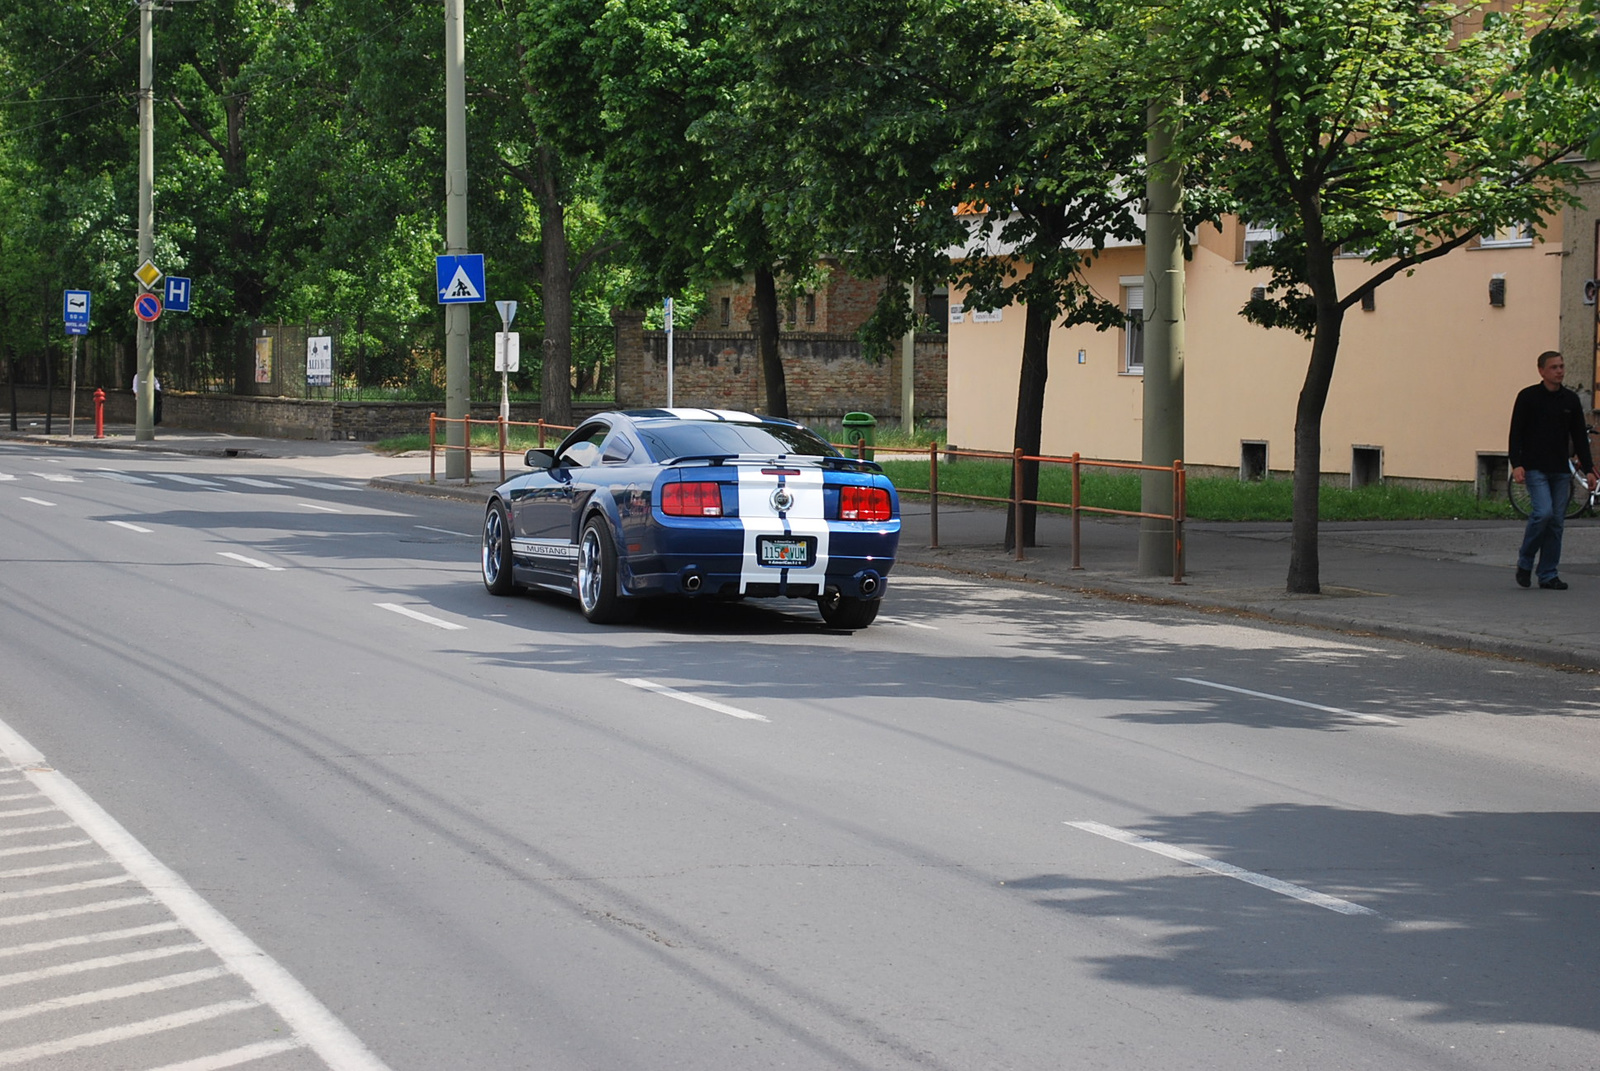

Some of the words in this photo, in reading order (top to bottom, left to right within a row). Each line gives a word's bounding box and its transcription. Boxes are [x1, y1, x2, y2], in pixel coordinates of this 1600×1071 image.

[169, 281, 185, 302] H
[526, 545, 567, 555] MUSTANG
[764, 546, 780, 558] 115
[790, 547, 805, 559] VUM
